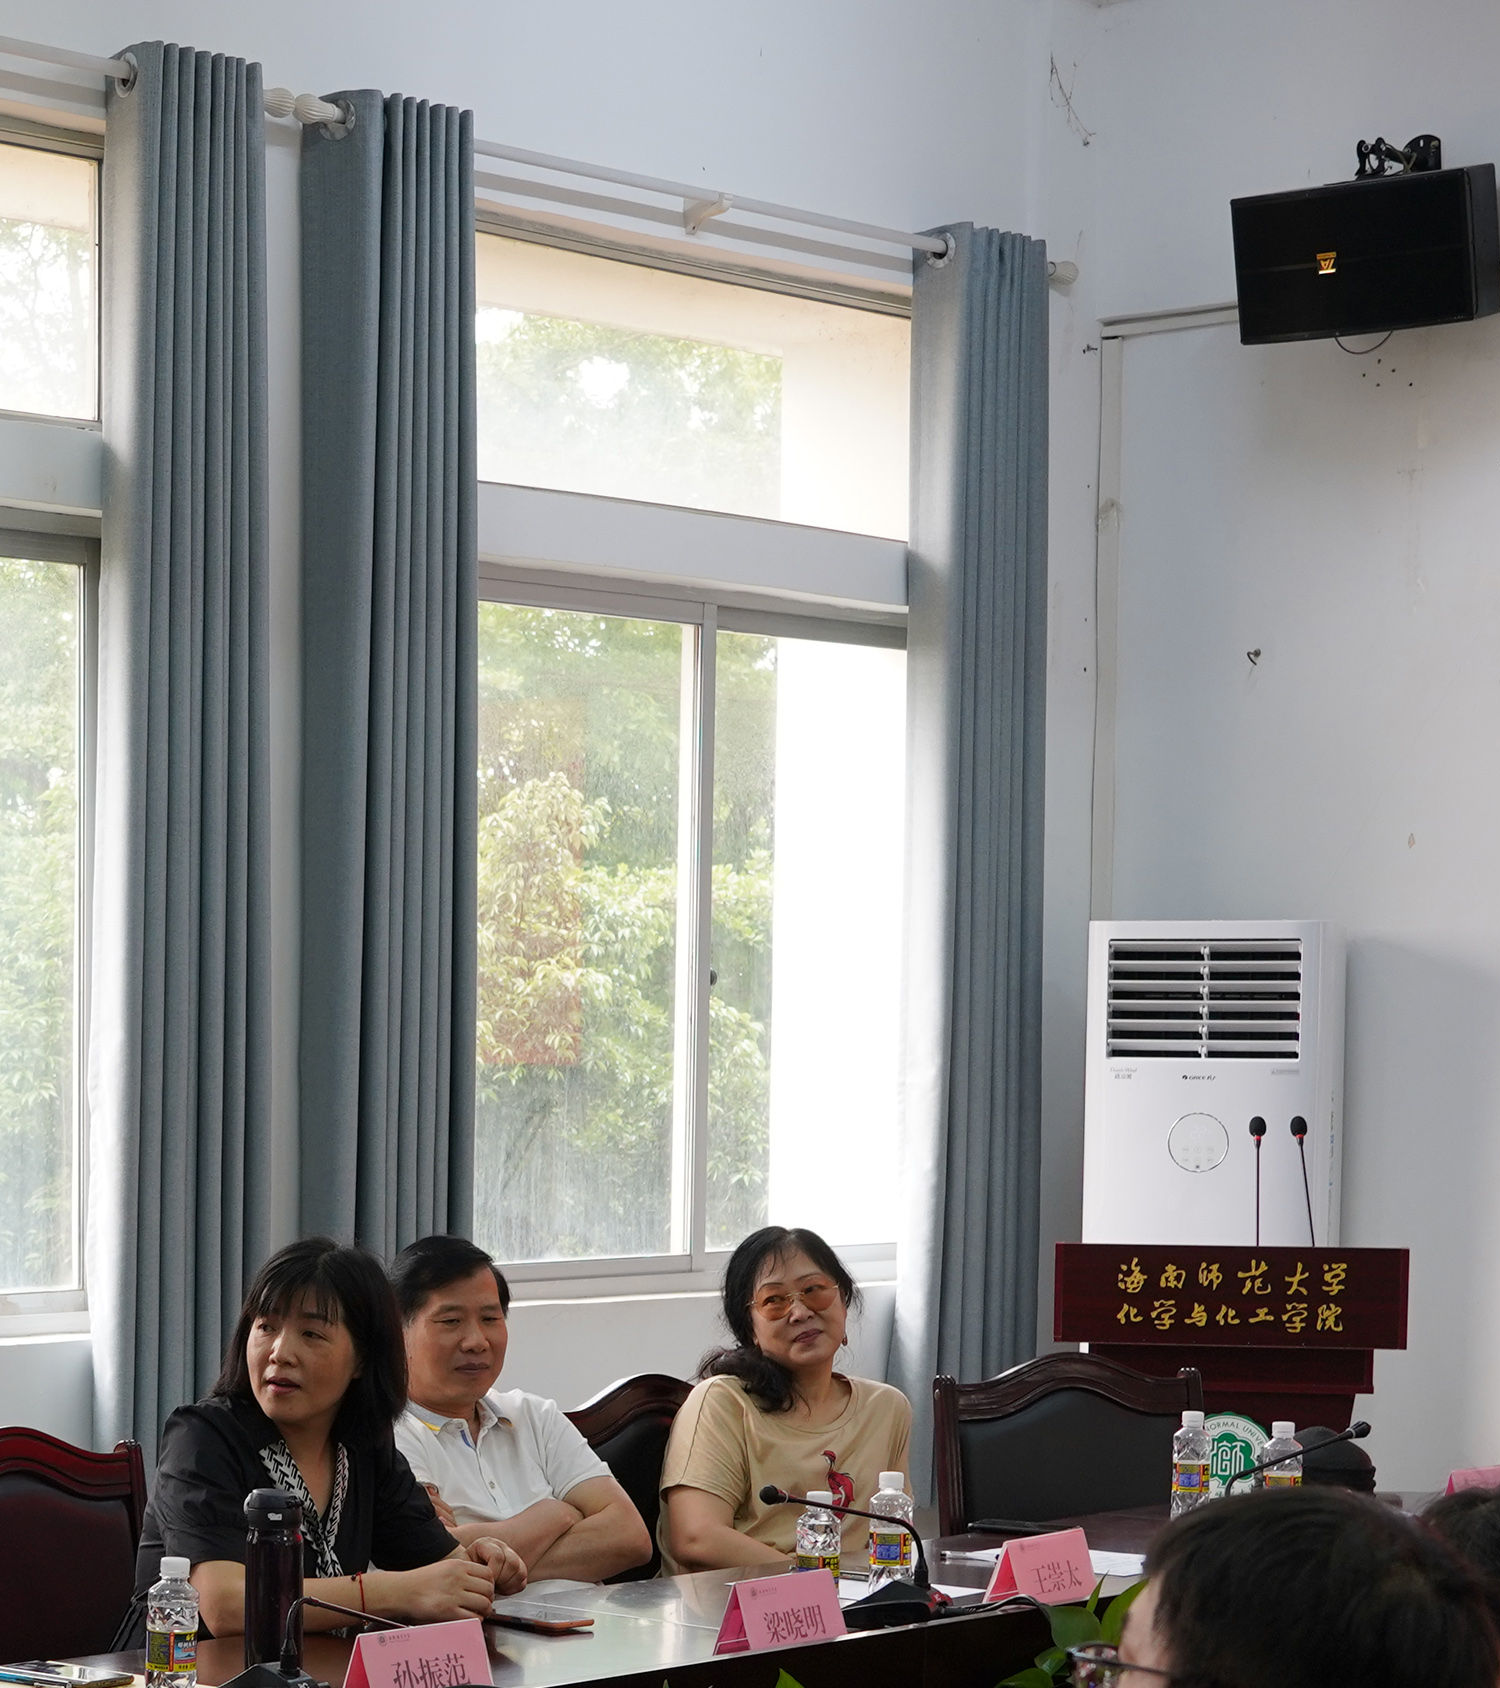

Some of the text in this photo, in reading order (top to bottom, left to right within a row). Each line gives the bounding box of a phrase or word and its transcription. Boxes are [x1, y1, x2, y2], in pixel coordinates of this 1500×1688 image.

[1117, 1257, 1348, 1296] 海南师范大学
[1116, 1300, 1344, 1333] 化学与化工学院
[1031, 1560, 1083, 1596] 王崇太
[763, 1604, 827, 1644] 梁晓明
